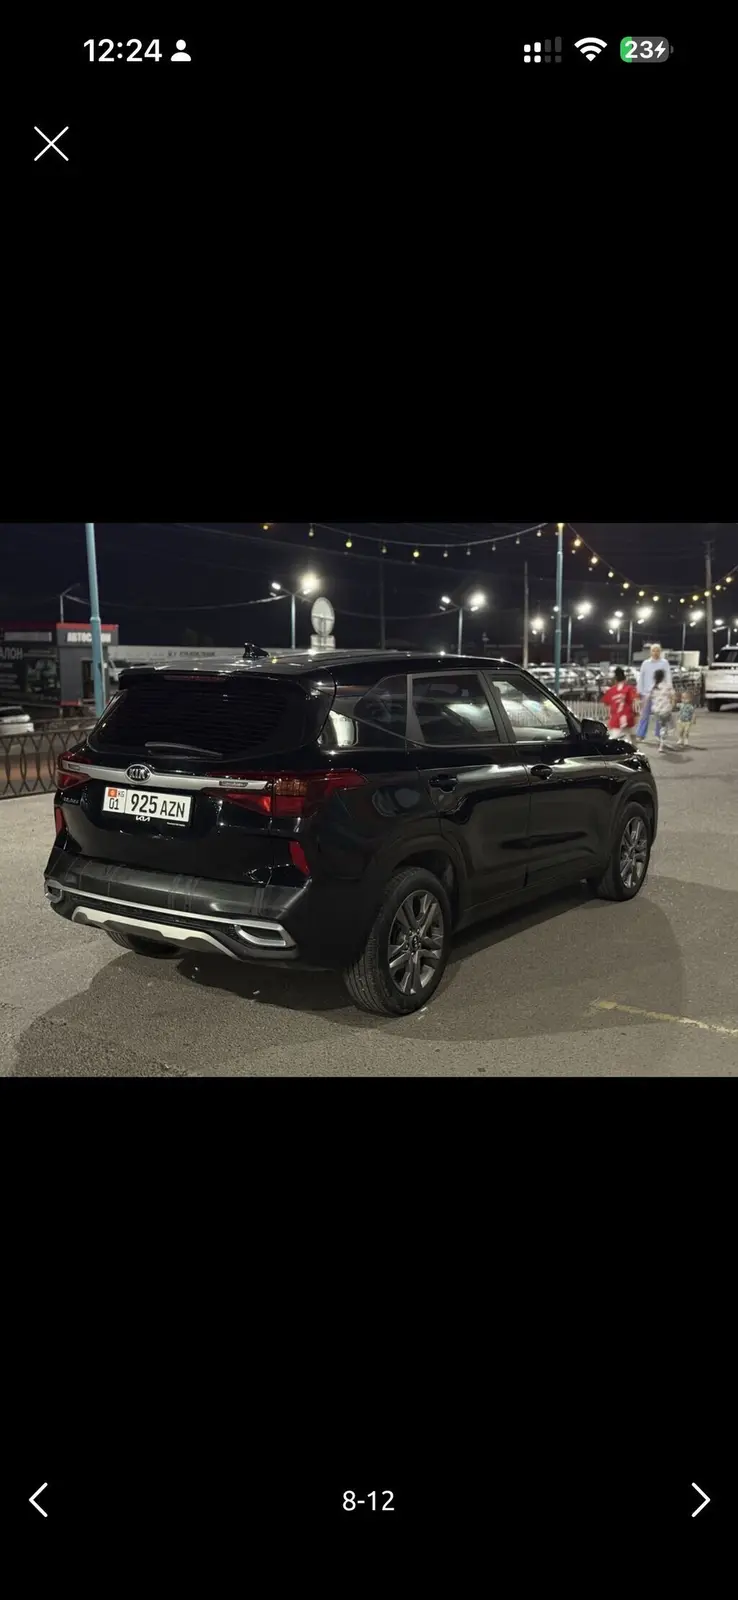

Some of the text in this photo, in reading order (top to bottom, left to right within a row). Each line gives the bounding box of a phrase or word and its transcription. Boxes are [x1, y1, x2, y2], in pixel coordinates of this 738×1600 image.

[67, 632, 111, 642] АВТОСОН
[108, 797, 119, 810] 01
[131, 793, 185, 818] 925 AZN
